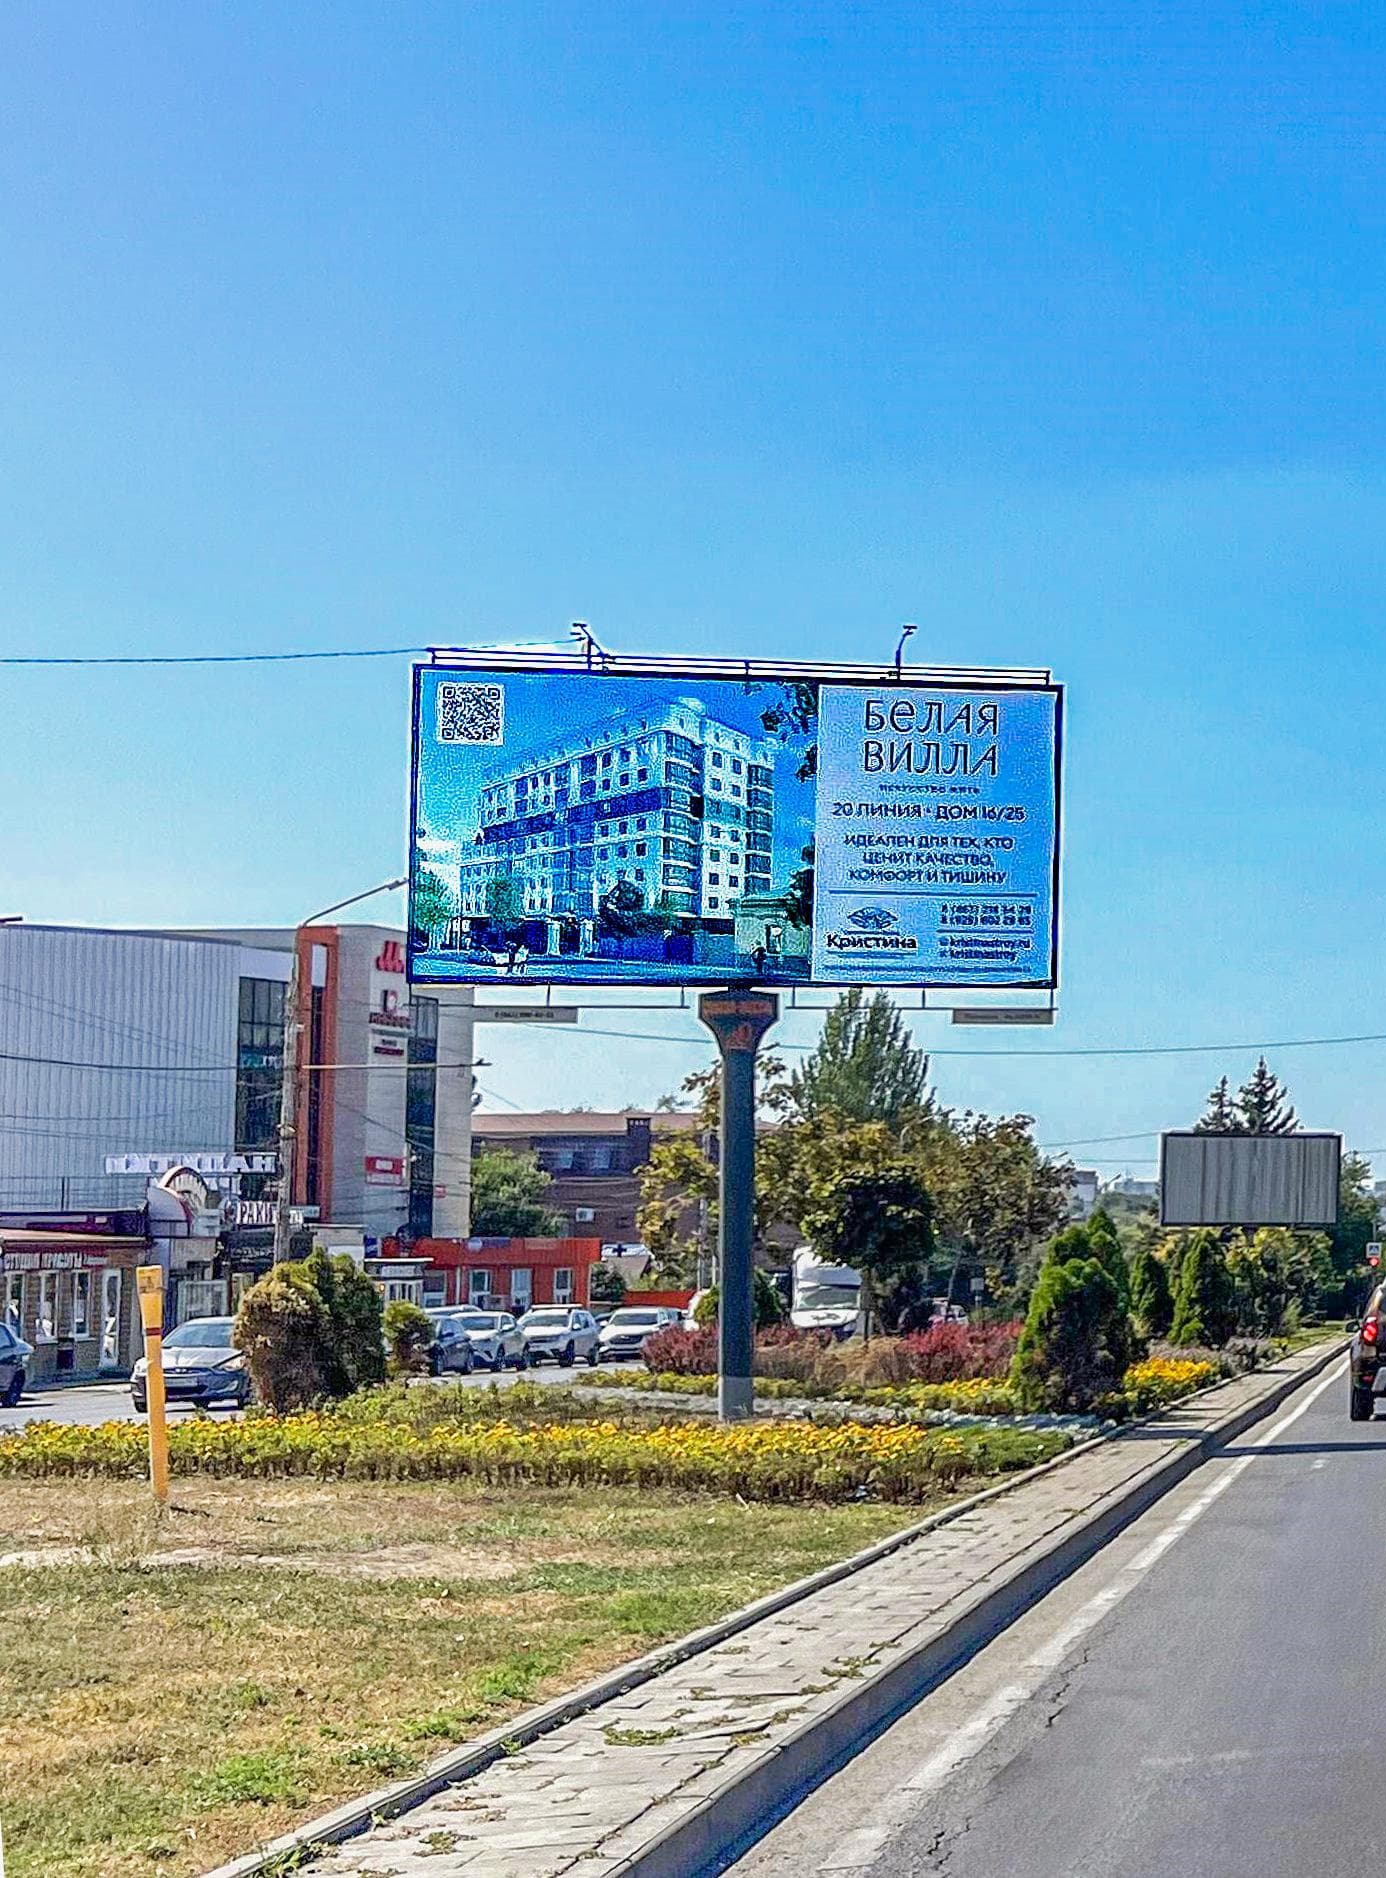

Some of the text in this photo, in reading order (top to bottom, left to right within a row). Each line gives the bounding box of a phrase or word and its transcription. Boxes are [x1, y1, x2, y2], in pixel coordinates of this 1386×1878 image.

[864, 739, 998, 775] ВИЛЛА
[832, 802, 1026, 822] 20 ЛИНИЯ ДОМ 16/25
[844, 834, 915, 849] ИДЕАЛЕН
[918, 835, 948, 849] ДЛЯ
[983, 837, 1014, 850] КТО
[863, 852, 912, 865] ЦЕНИТ
[849, 869, 1007, 884] КОМФОРТ И ТИШИНУ
[826, 934, 917, 951] Кристина
